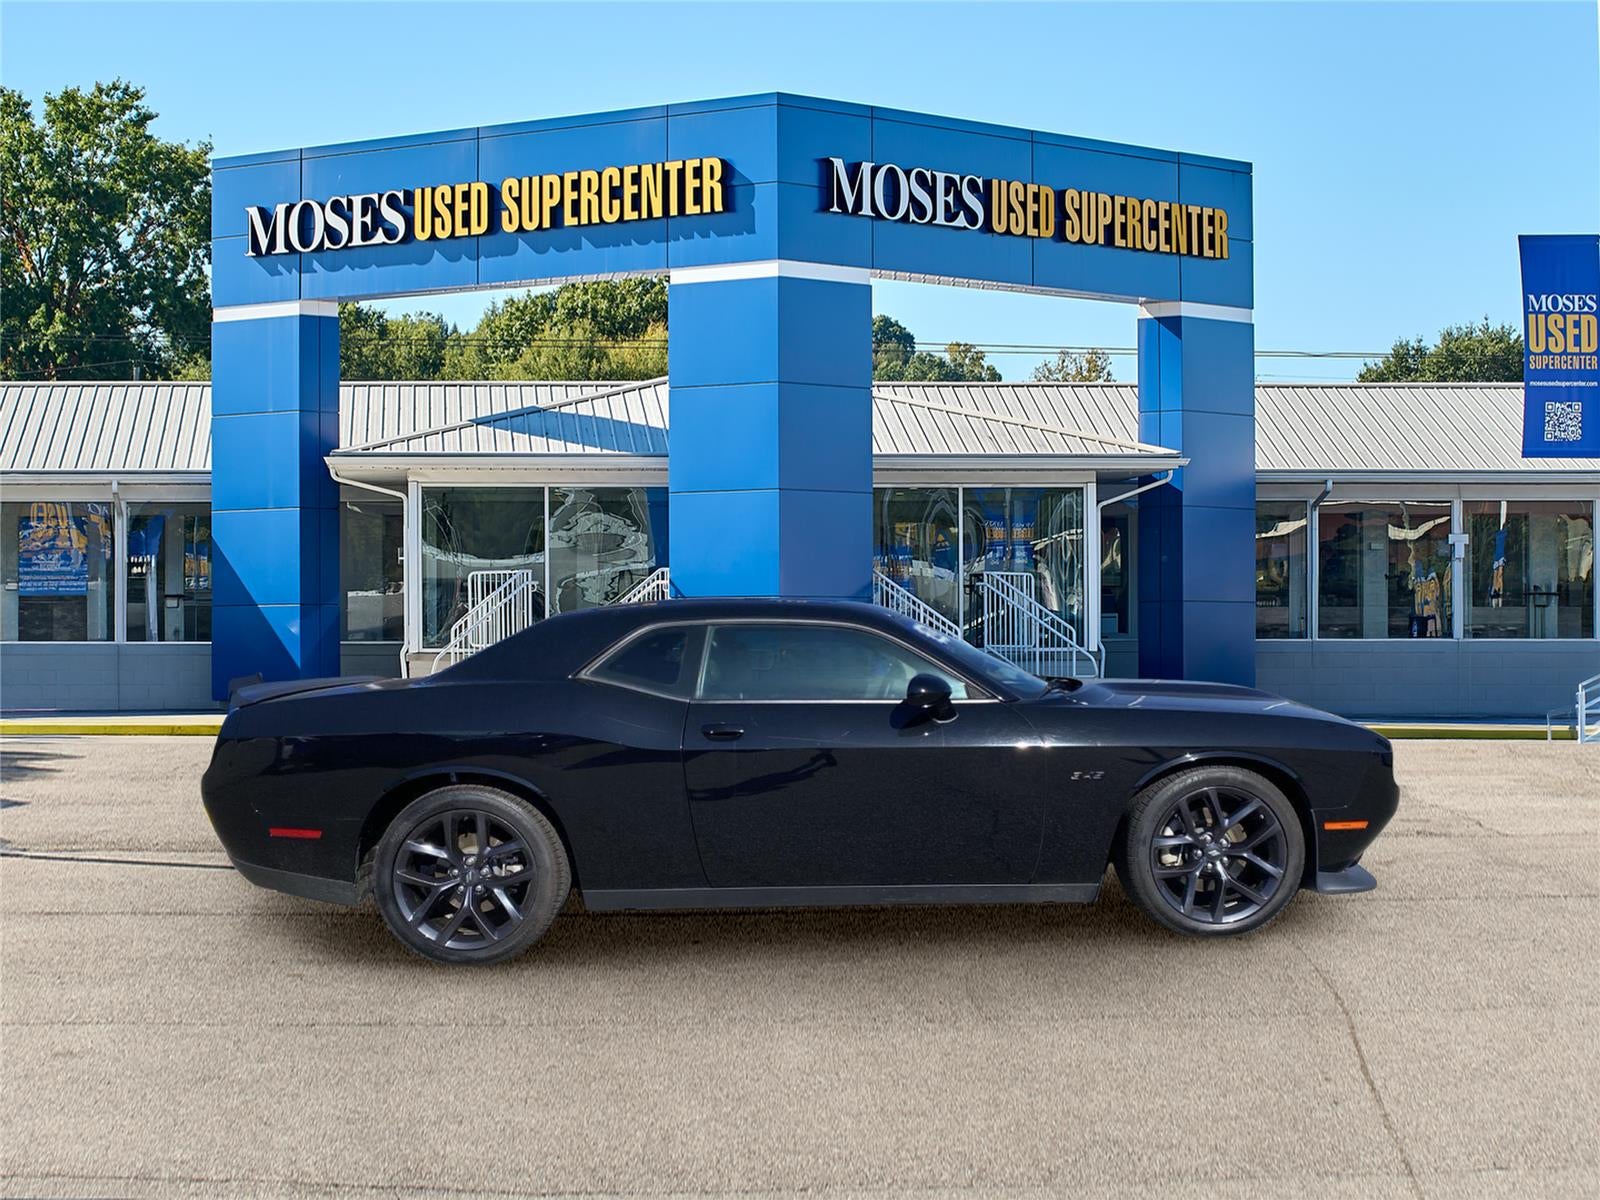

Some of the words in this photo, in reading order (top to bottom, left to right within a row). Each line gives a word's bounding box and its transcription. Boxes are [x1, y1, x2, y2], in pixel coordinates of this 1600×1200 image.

[244, 189, 408, 257] MOSES
[413, 181, 489, 242] USED
[501, 156, 725, 234] SUPERCENTER
[828, 156, 985, 231] MOSES
[991, 178, 1055, 239] USED
[1064, 187, 1230, 260] SUPERCENTER
[1527, 294, 1598, 313] MOSES
[1528, 313, 1598, 354] USED
[1529, 355, 1598, 370] SUPERCENTER
